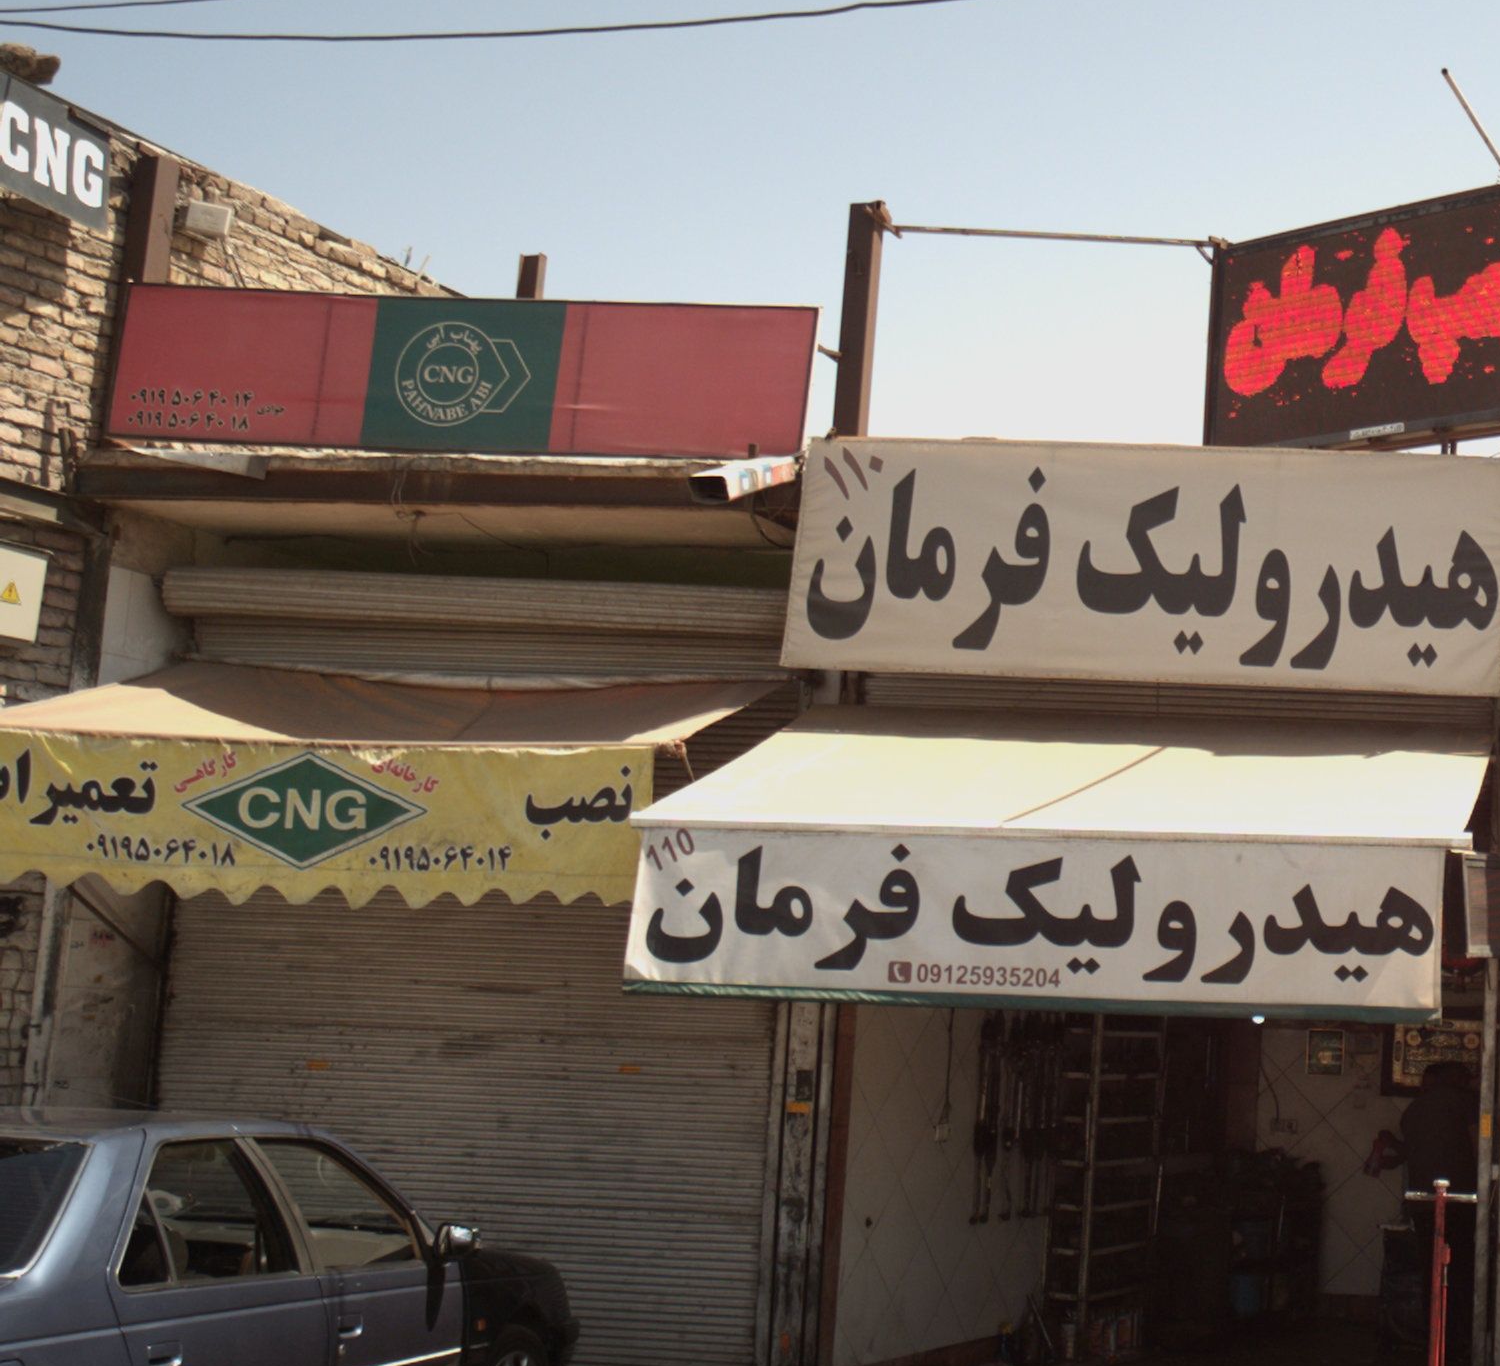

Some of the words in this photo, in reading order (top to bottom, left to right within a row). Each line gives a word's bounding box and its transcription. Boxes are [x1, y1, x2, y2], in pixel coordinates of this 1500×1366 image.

[0, 100, 104, 208] CNG
[402, 379, 469, 421] PAHNABE
[470, 380, 493, 411] ABI
[423, 365, 475, 384] CNG
[806, 467, 1050, 651] فرمان
[1076, 483, 1500, 670] هیدرولیک
[0, 748, 158, 826] تعمیرا
[237, 786, 367, 832] CNG
[525, 765, 632, 841] نصب
[86, 833, 236, 867] ۰۹۱۹۵۰۶۴۰۱۸
[368, 845, 512, 872] ۰۹۱۹۵۰۶۴۰۱۴
[647, 829, 696, 871] 110
[644, 844, 921, 973] فرمان
[950, 854, 1436, 986] هیدرولیک
[916, 963, 1062, 988] 09125935204
